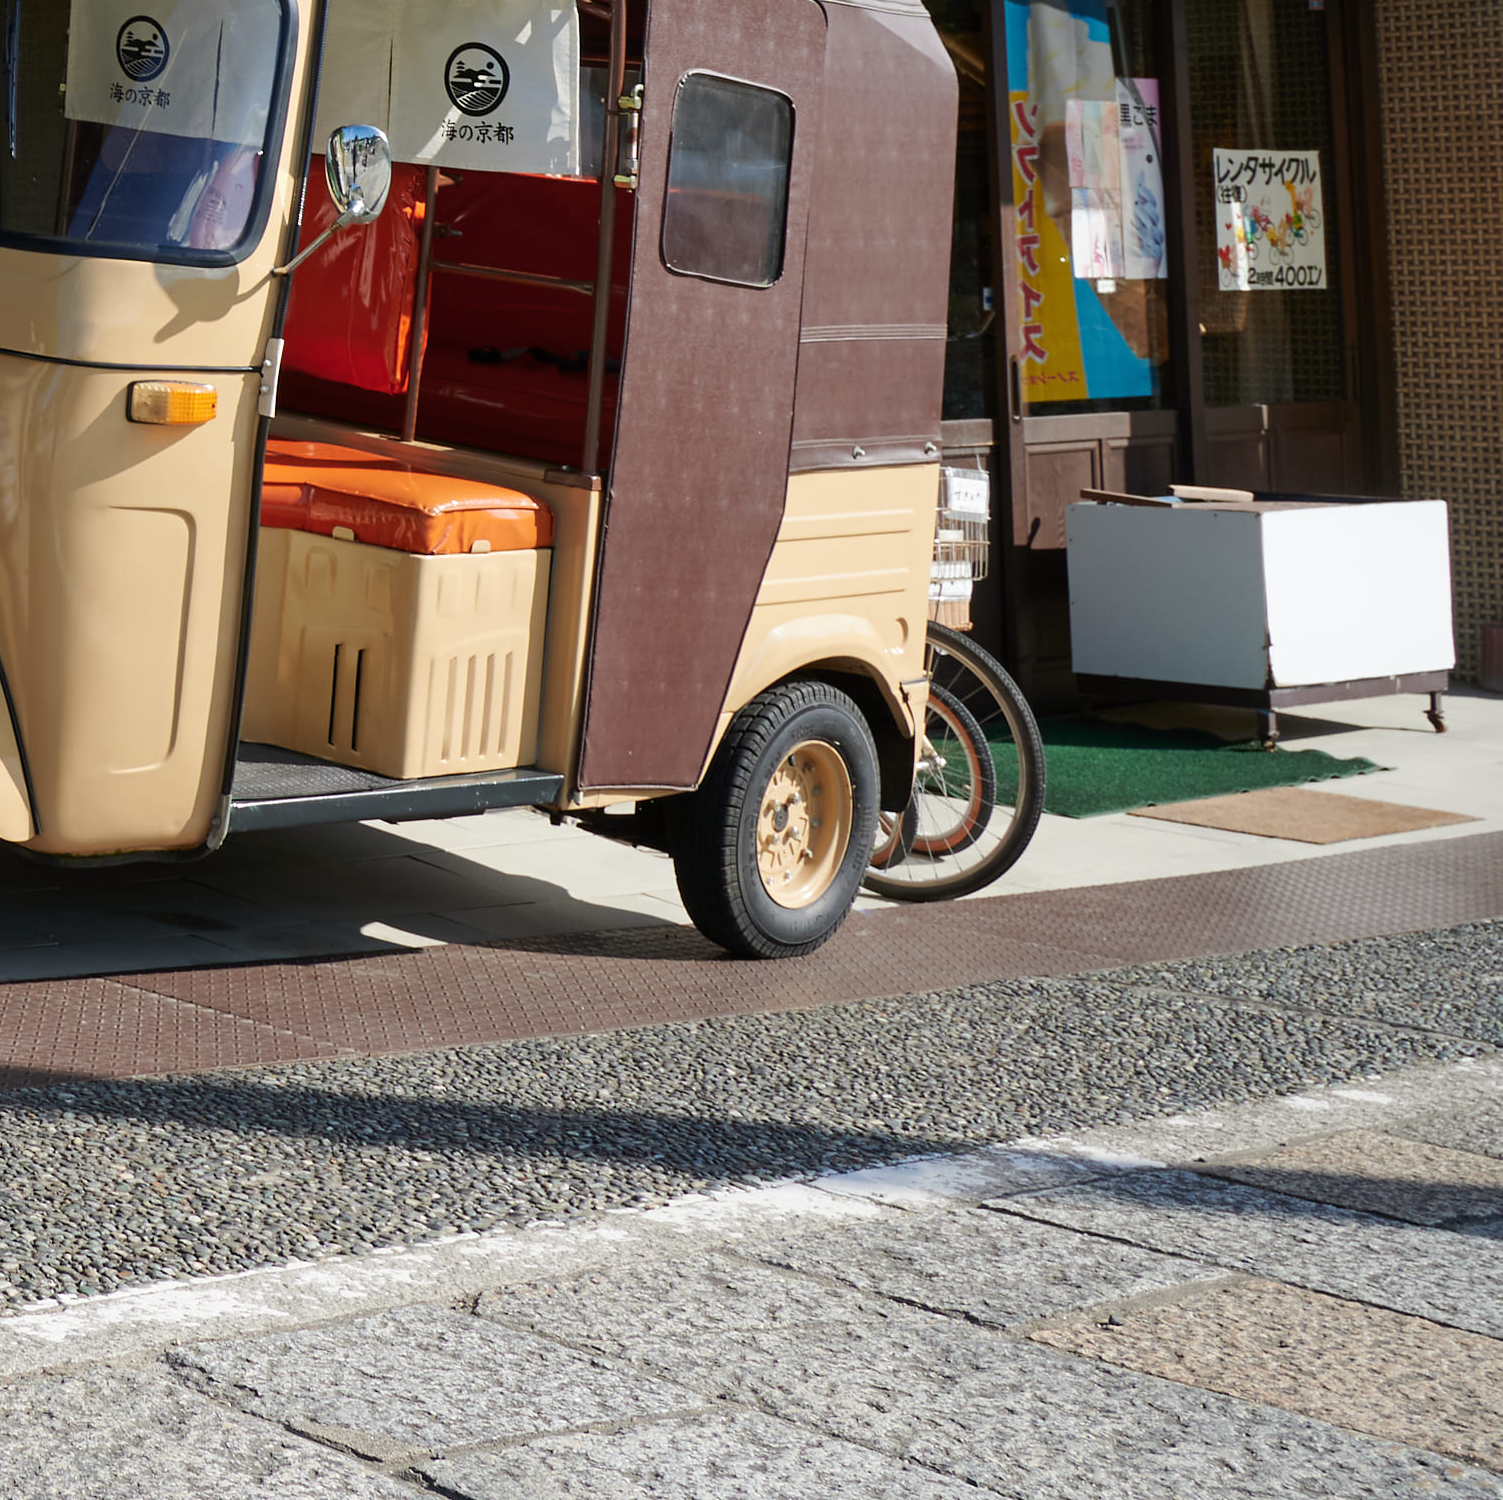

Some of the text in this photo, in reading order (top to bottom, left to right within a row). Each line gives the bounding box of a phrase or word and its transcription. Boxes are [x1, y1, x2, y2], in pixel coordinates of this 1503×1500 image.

[110, 82, 171, 110] 海の京都
[441, 119, 514, 146] 海の京都
[1216, 155, 1317, 186] レンタサイクル
